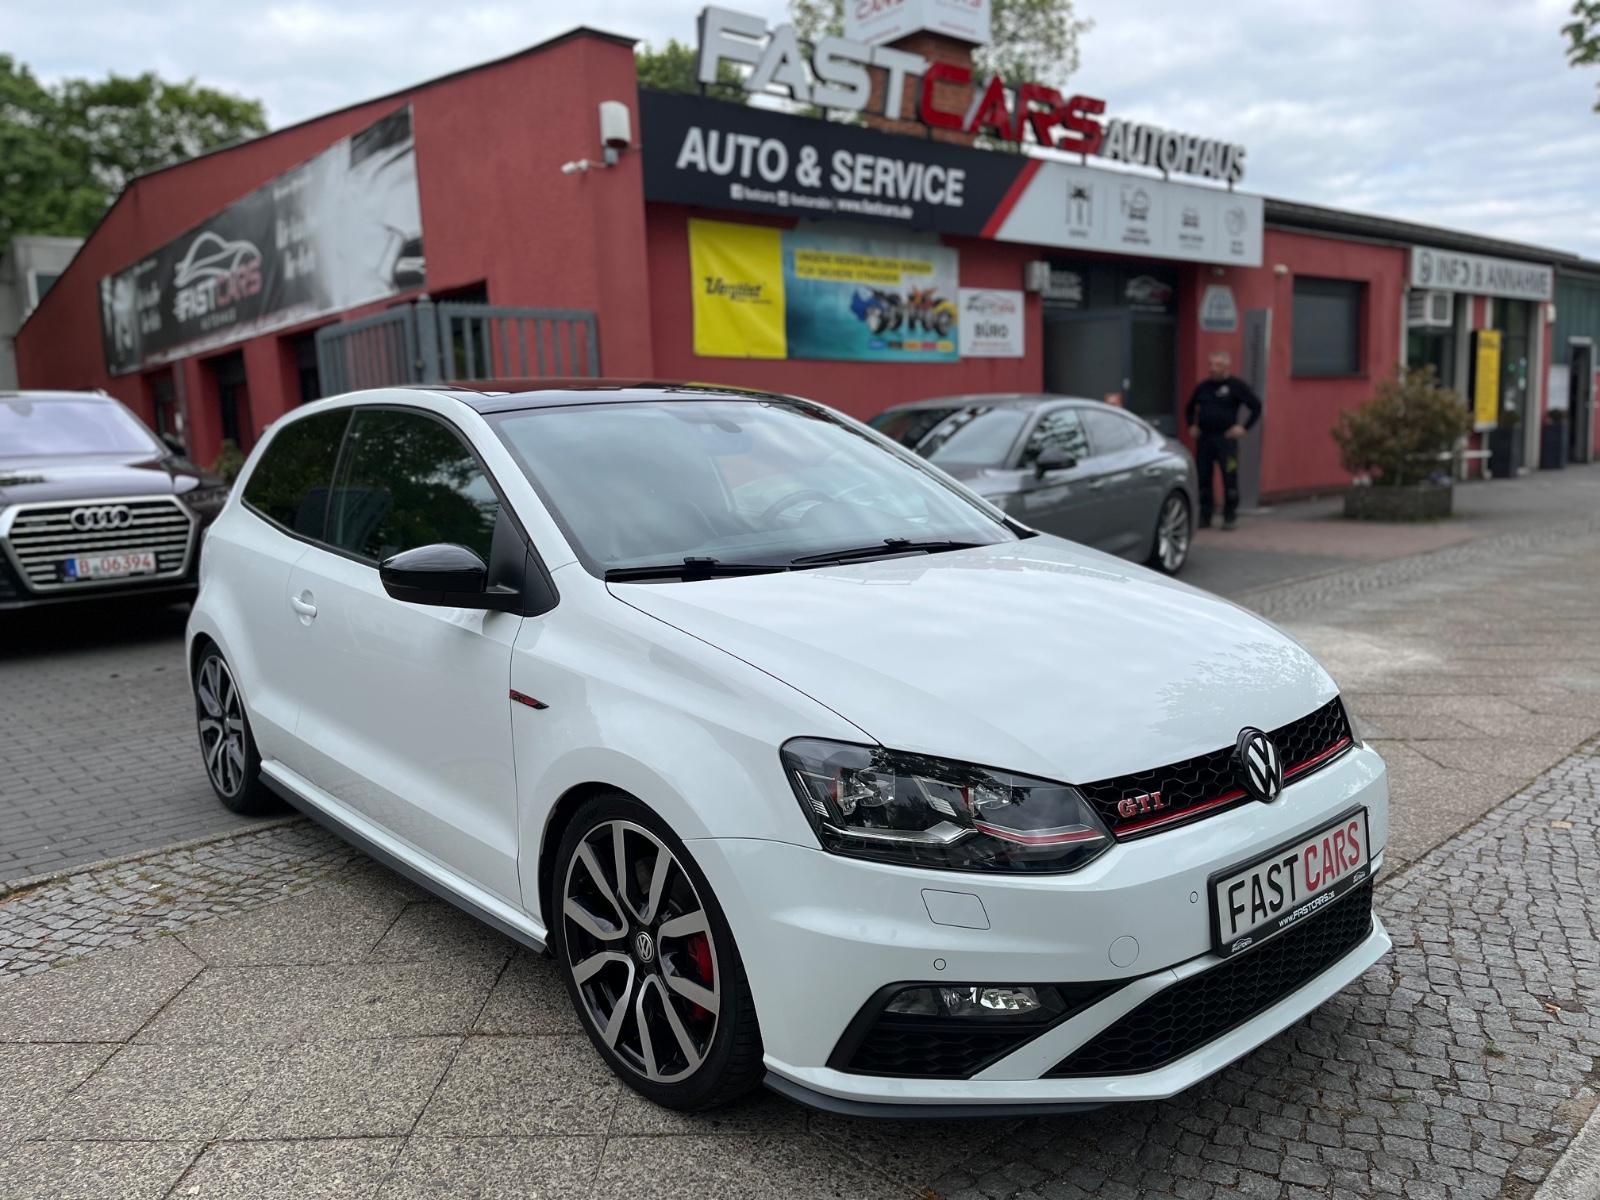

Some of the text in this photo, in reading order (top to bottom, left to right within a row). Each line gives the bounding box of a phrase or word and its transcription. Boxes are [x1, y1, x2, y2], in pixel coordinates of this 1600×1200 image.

[677, 126, 966, 207] AUTO & SERVICE
[1104, 118, 1245, 180] AUTOHAUS
[101, 554, 152, 573] 06394
[1117, 791, 1164, 818] GTI
